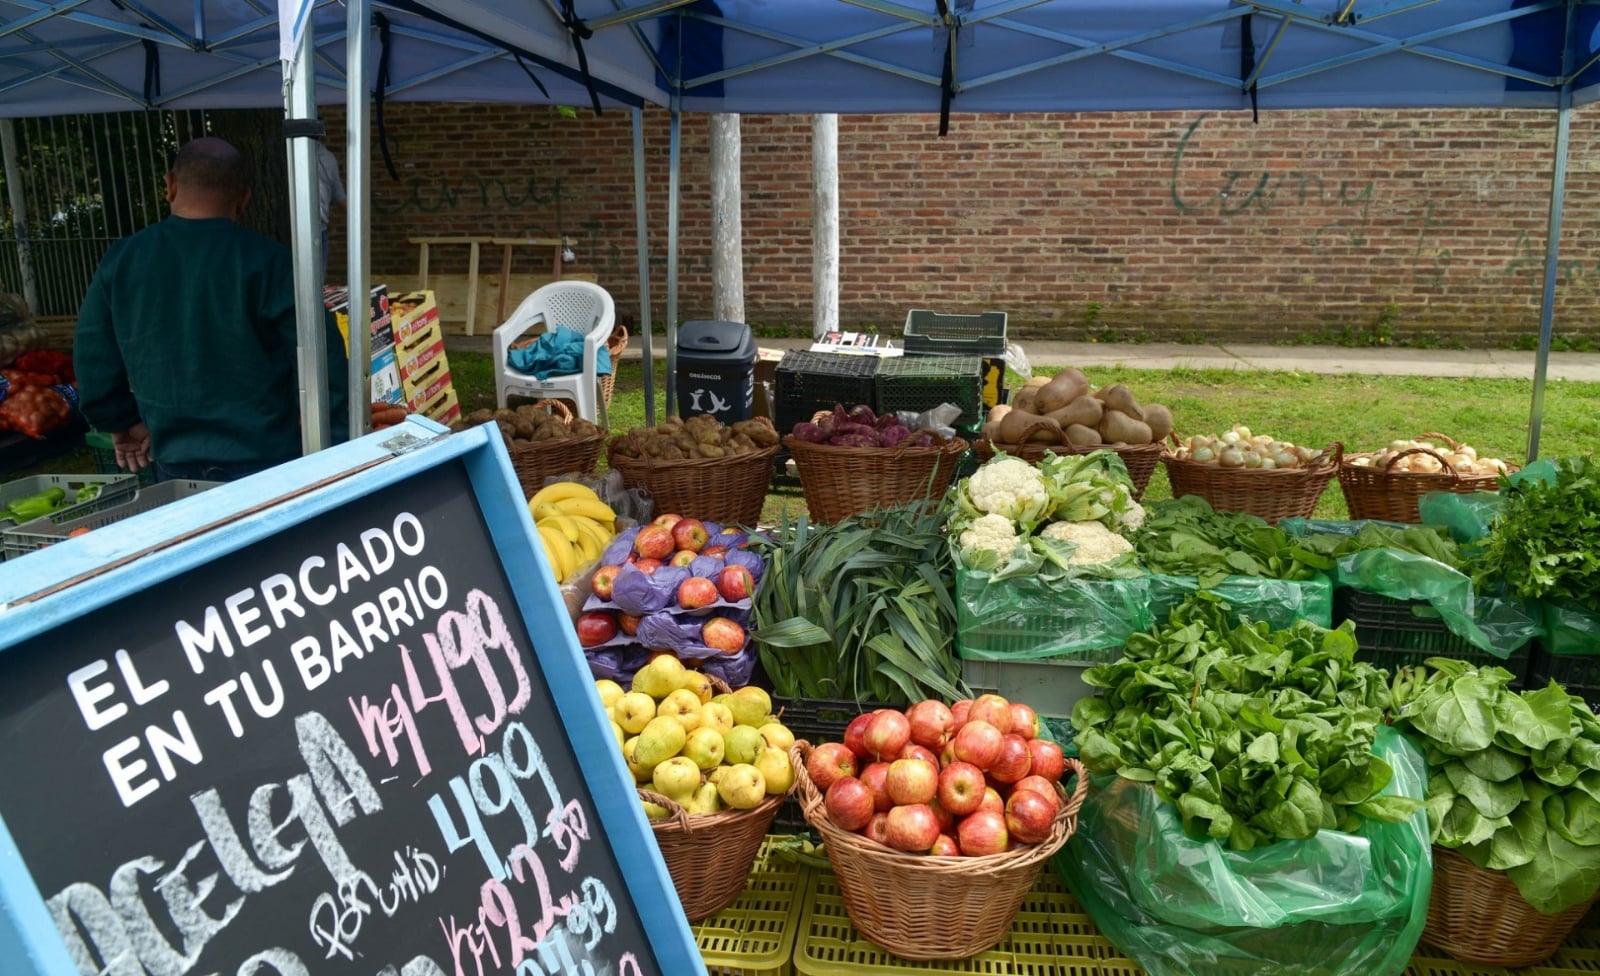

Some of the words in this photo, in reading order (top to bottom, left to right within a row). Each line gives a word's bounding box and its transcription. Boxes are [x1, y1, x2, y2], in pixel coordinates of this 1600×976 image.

[67, 648, 170, 731] EL
[174, 511, 425, 674] MERCADO
[102, 709, 203, 808] EN
[204, 659, 285, 738] TU
[290, 565, 448, 691] BARRIO
